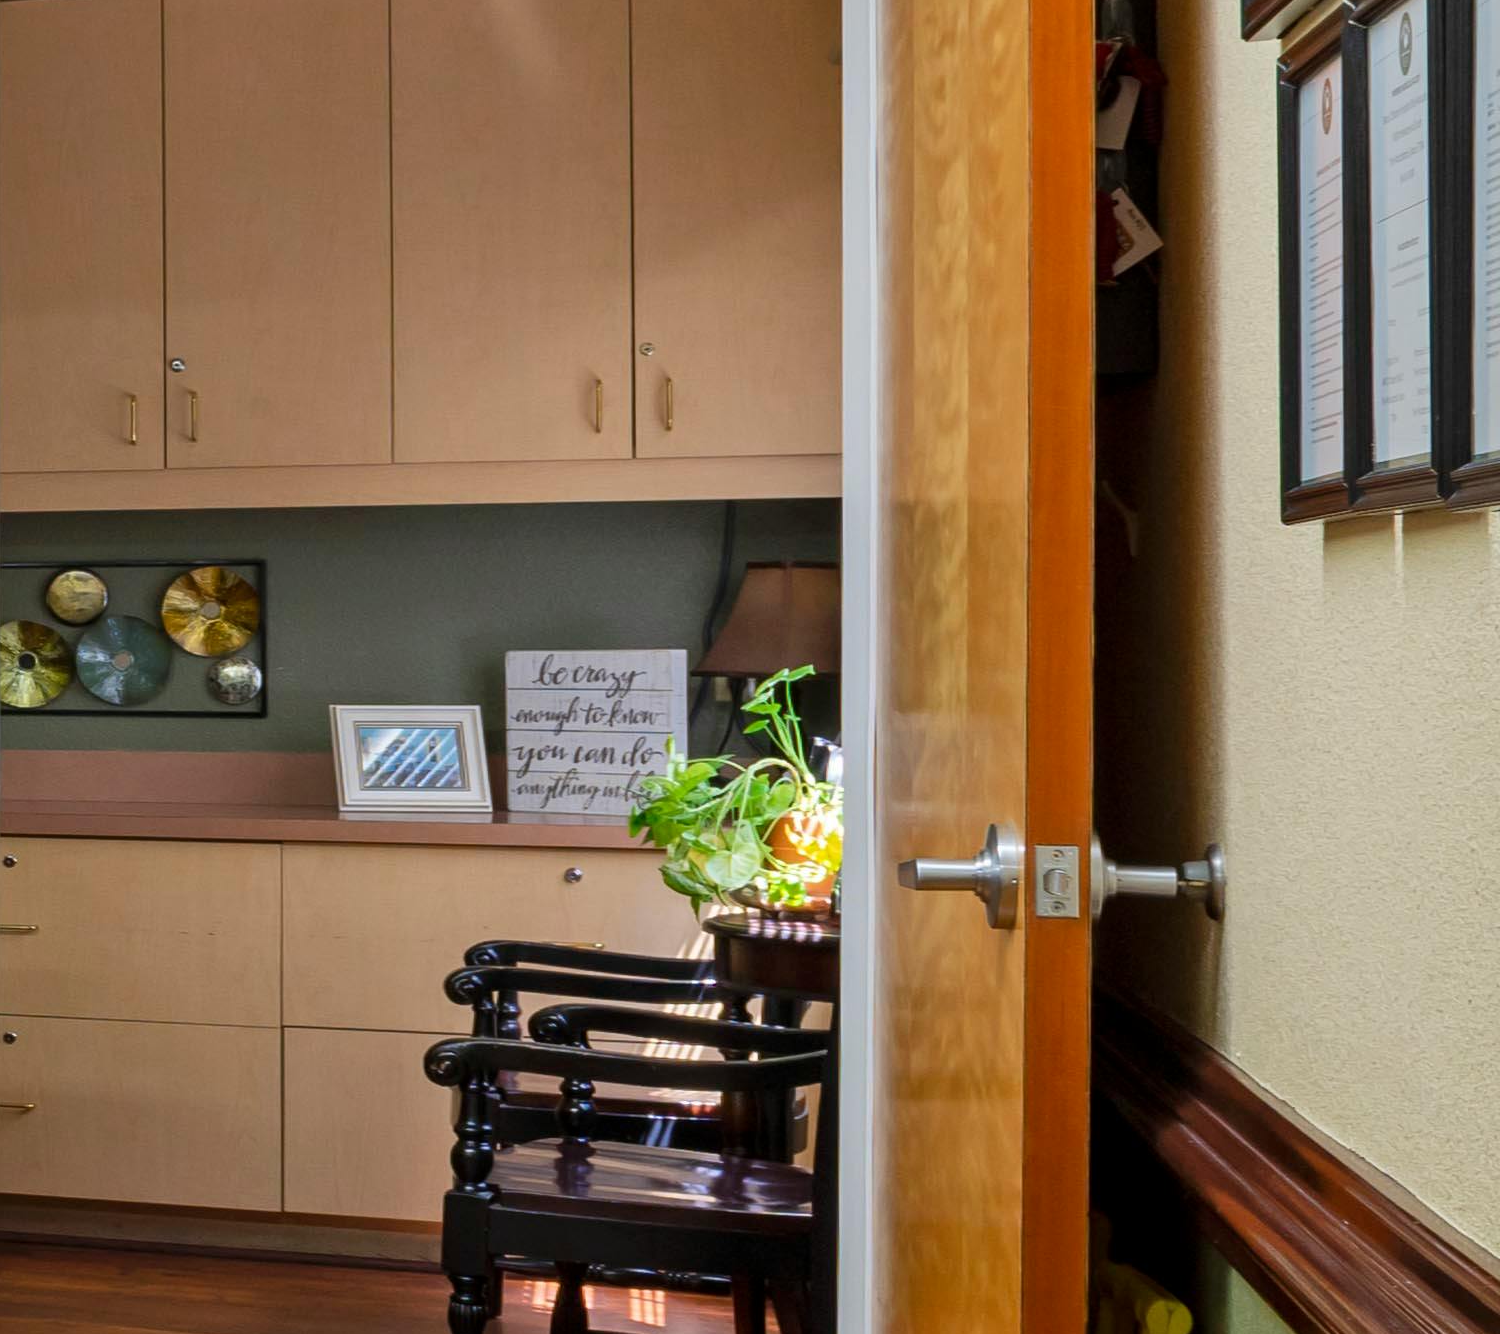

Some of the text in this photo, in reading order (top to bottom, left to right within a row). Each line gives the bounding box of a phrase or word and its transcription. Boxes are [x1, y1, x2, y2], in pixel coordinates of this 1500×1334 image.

[532, 654, 647, 698] be crazy
[511, 696, 665, 736] enough to know
[512, 736, 663, 778] you can do
[511, 768, 599, 810] anything
